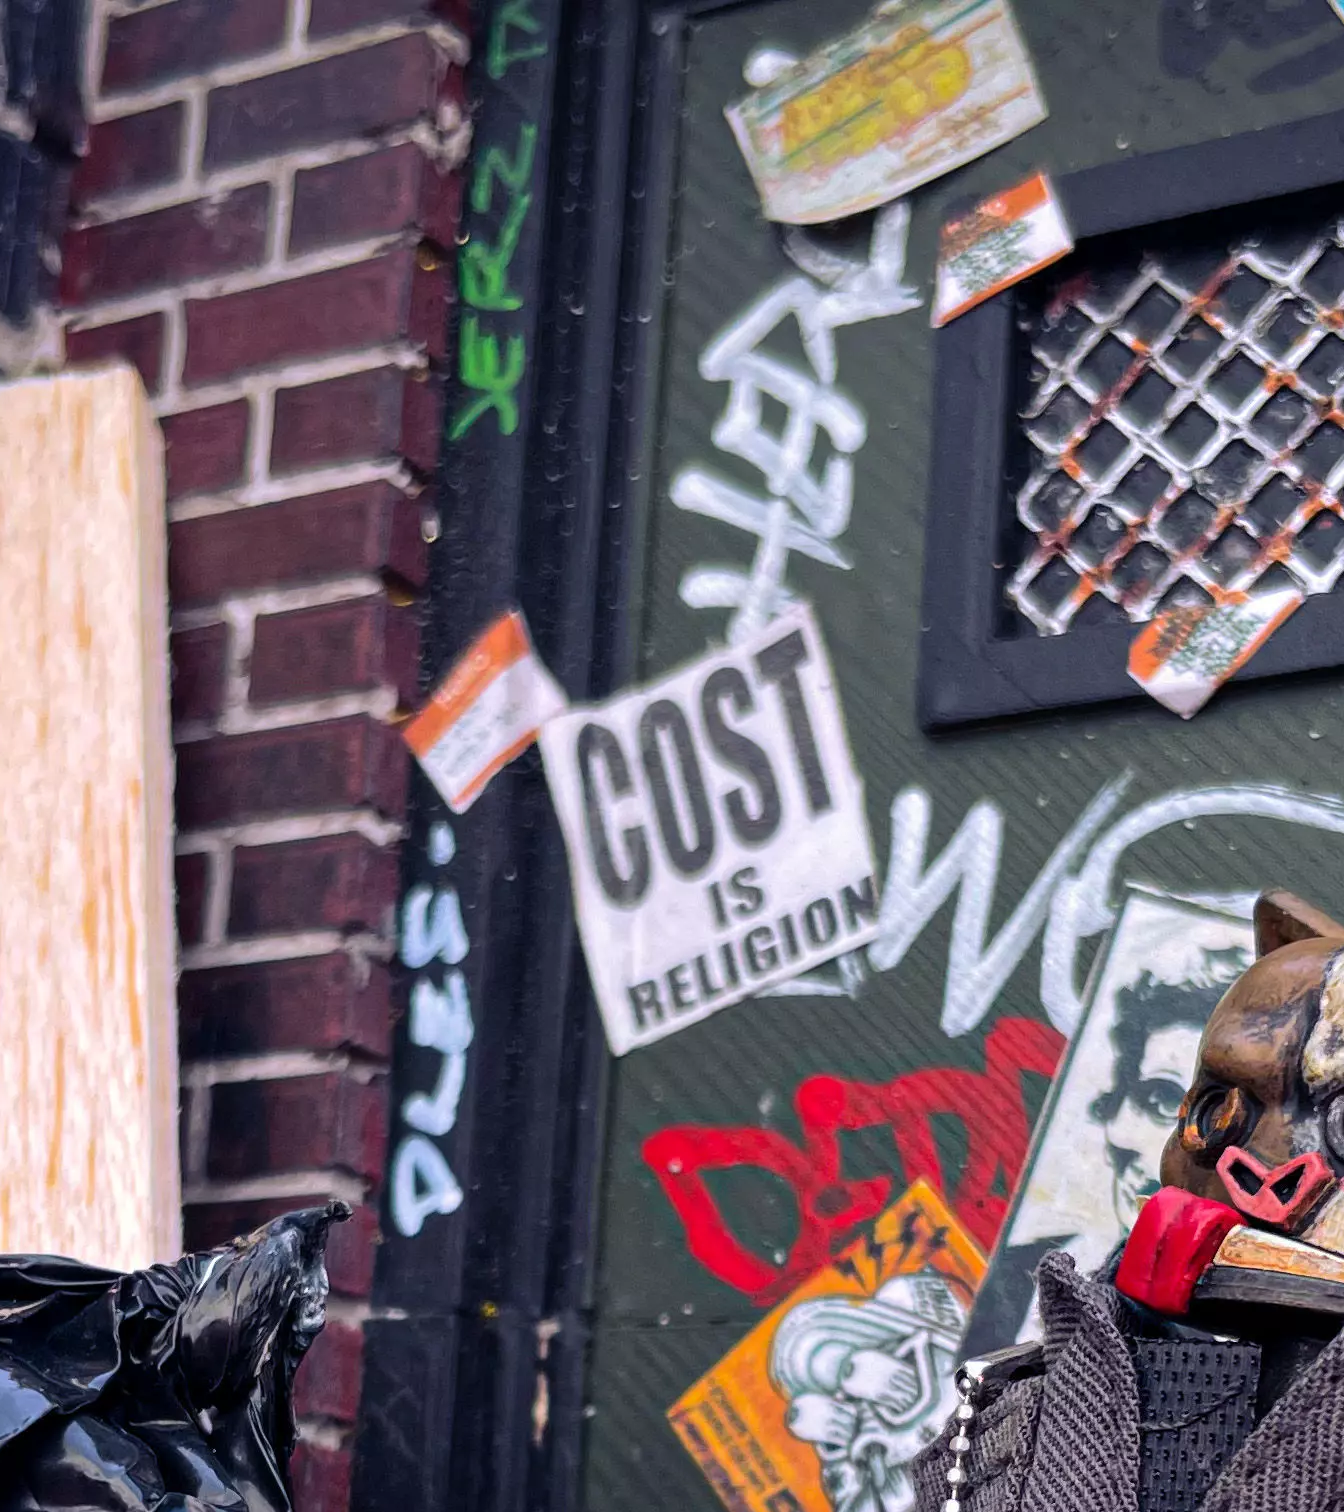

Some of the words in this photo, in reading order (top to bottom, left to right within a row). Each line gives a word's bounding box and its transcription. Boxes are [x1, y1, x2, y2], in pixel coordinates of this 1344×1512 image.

[576, 629, 836, 912] COST
[628, 875, 878, 1030] RELIGION
[709, 865, 764, 932] IS
